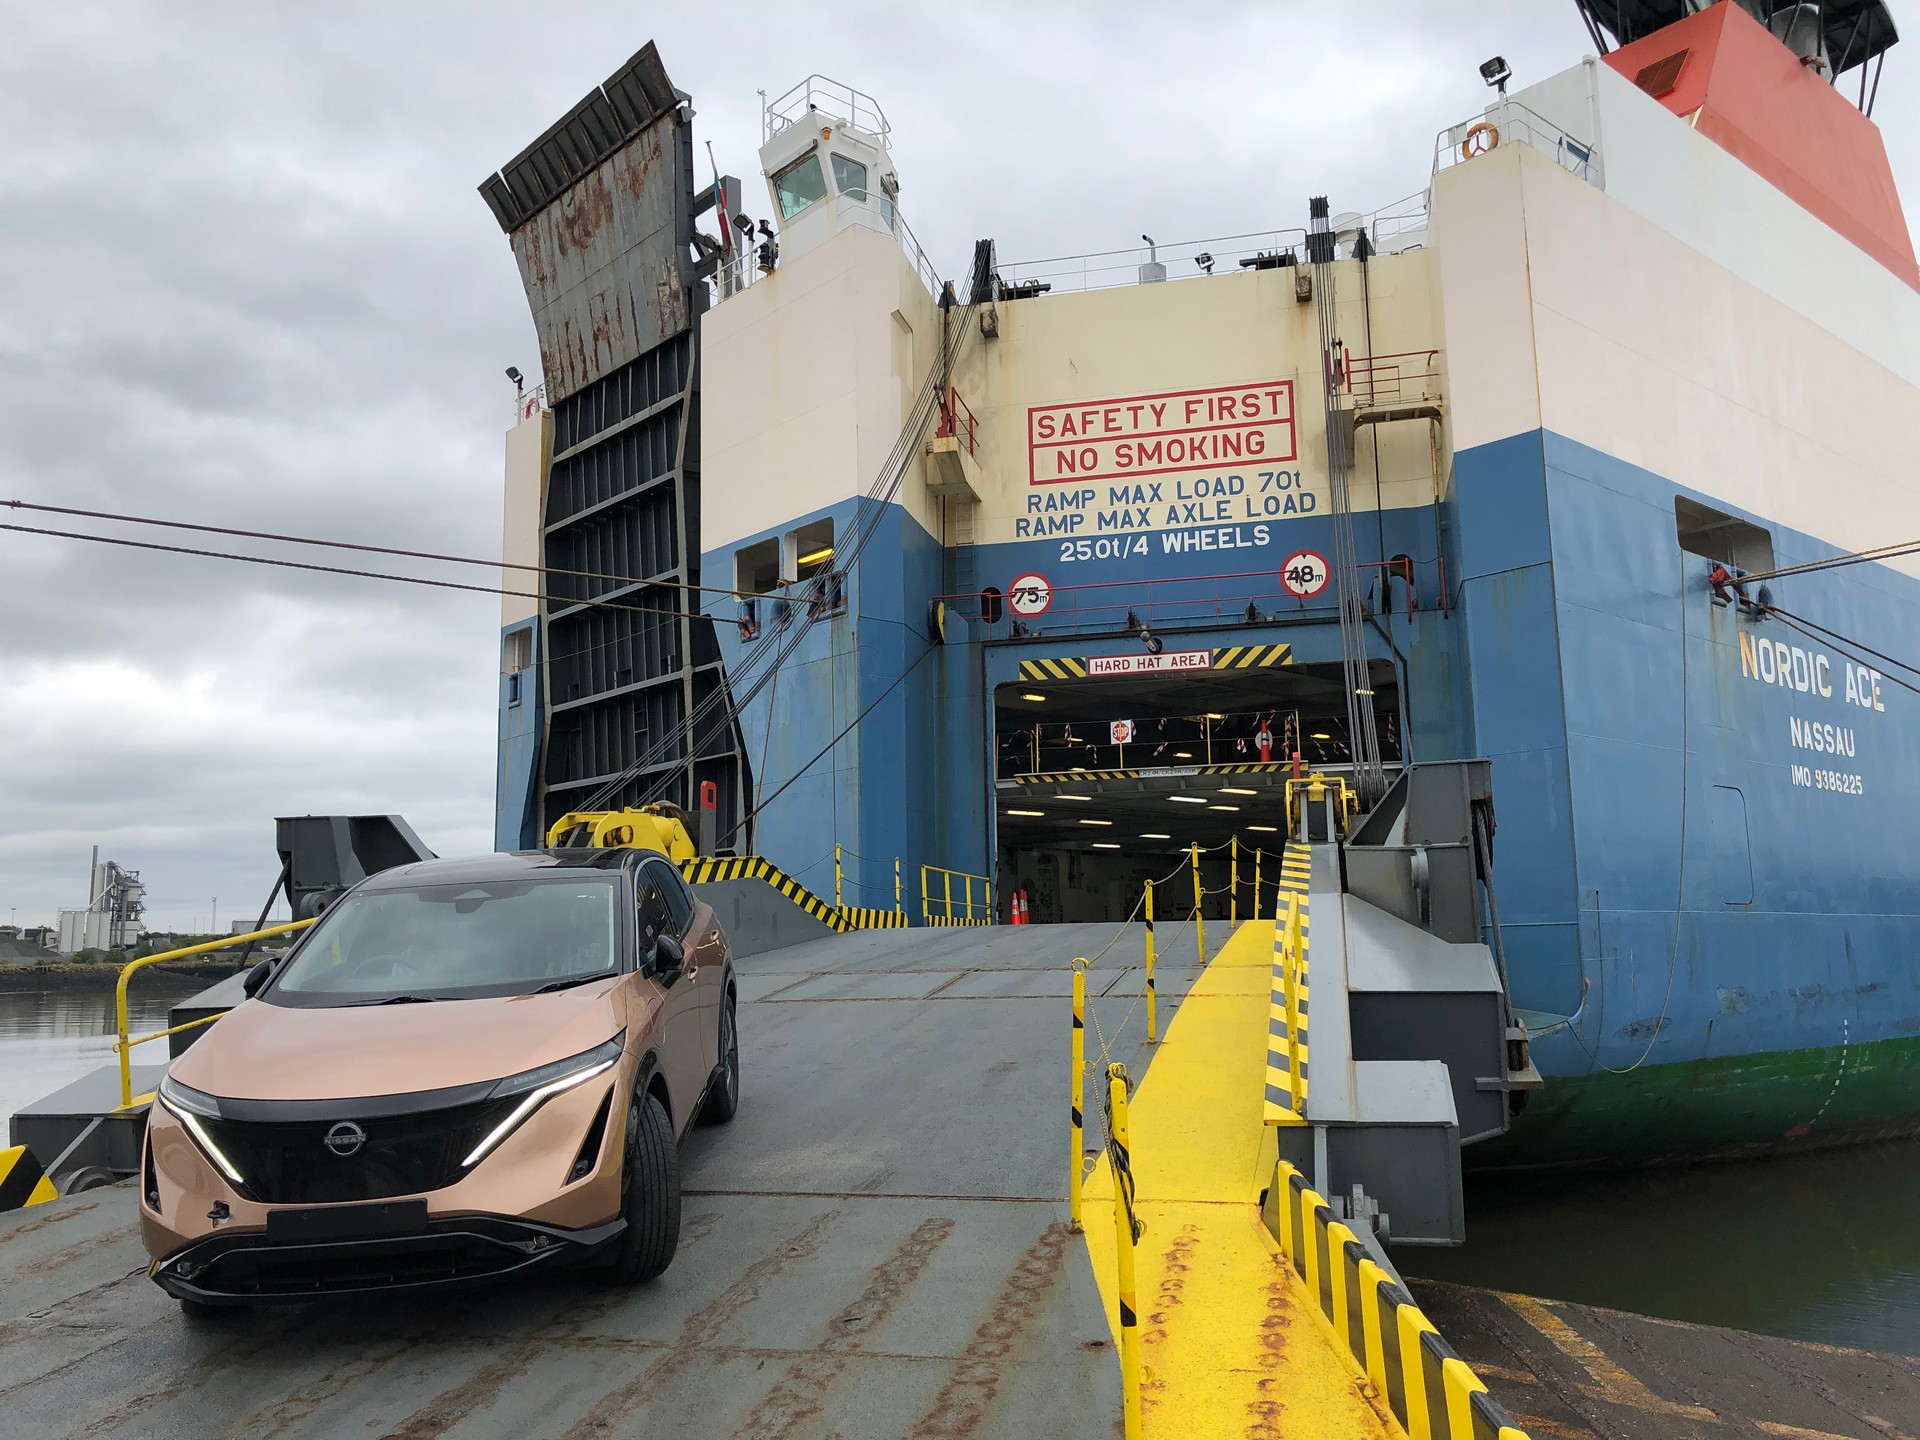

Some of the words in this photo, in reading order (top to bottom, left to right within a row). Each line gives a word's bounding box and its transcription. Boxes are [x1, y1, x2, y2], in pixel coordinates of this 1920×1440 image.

[1037, 403, 1167, 439] SAFETY
[1185, 391, 1284, 424] FIRST
[1057, 447, 1098, 474] NO
[1115, 430, 1265, 468] SMOKING
[1027, 489, 1096, 513] RAMP
[1109, 482, 1163, 506] MAX
[1177, 475, 1245, 500] LOAD
[1258, 470, 1302, 493] 70t
[1015, 513, 1084, 537] RAMP
[1097, 507, 1151, 531] MAX
[1166, 500, 1233, 525] AXLE
[1246, 492, 1316, 518] LOAD
[1162, 525, 1271, 554] WHEELS
[1095, 659, 1131, 672] HARD
[1137, 657, 1162, 669] HAT
[1171, 654, 1207, 667] AREA
[1739, 631, 1832, 698] NORDIC
[1845, 663, 1885, 713] ACE
[1113, 727, 1128, 738] STOP
[1789, 716, 1855, 757] NASSAU
[1791, 764, 1811, 787] IMO
[1815, 769, 1863, 795] 9386225
[324, 1134, 366, 1145] NISSAN
